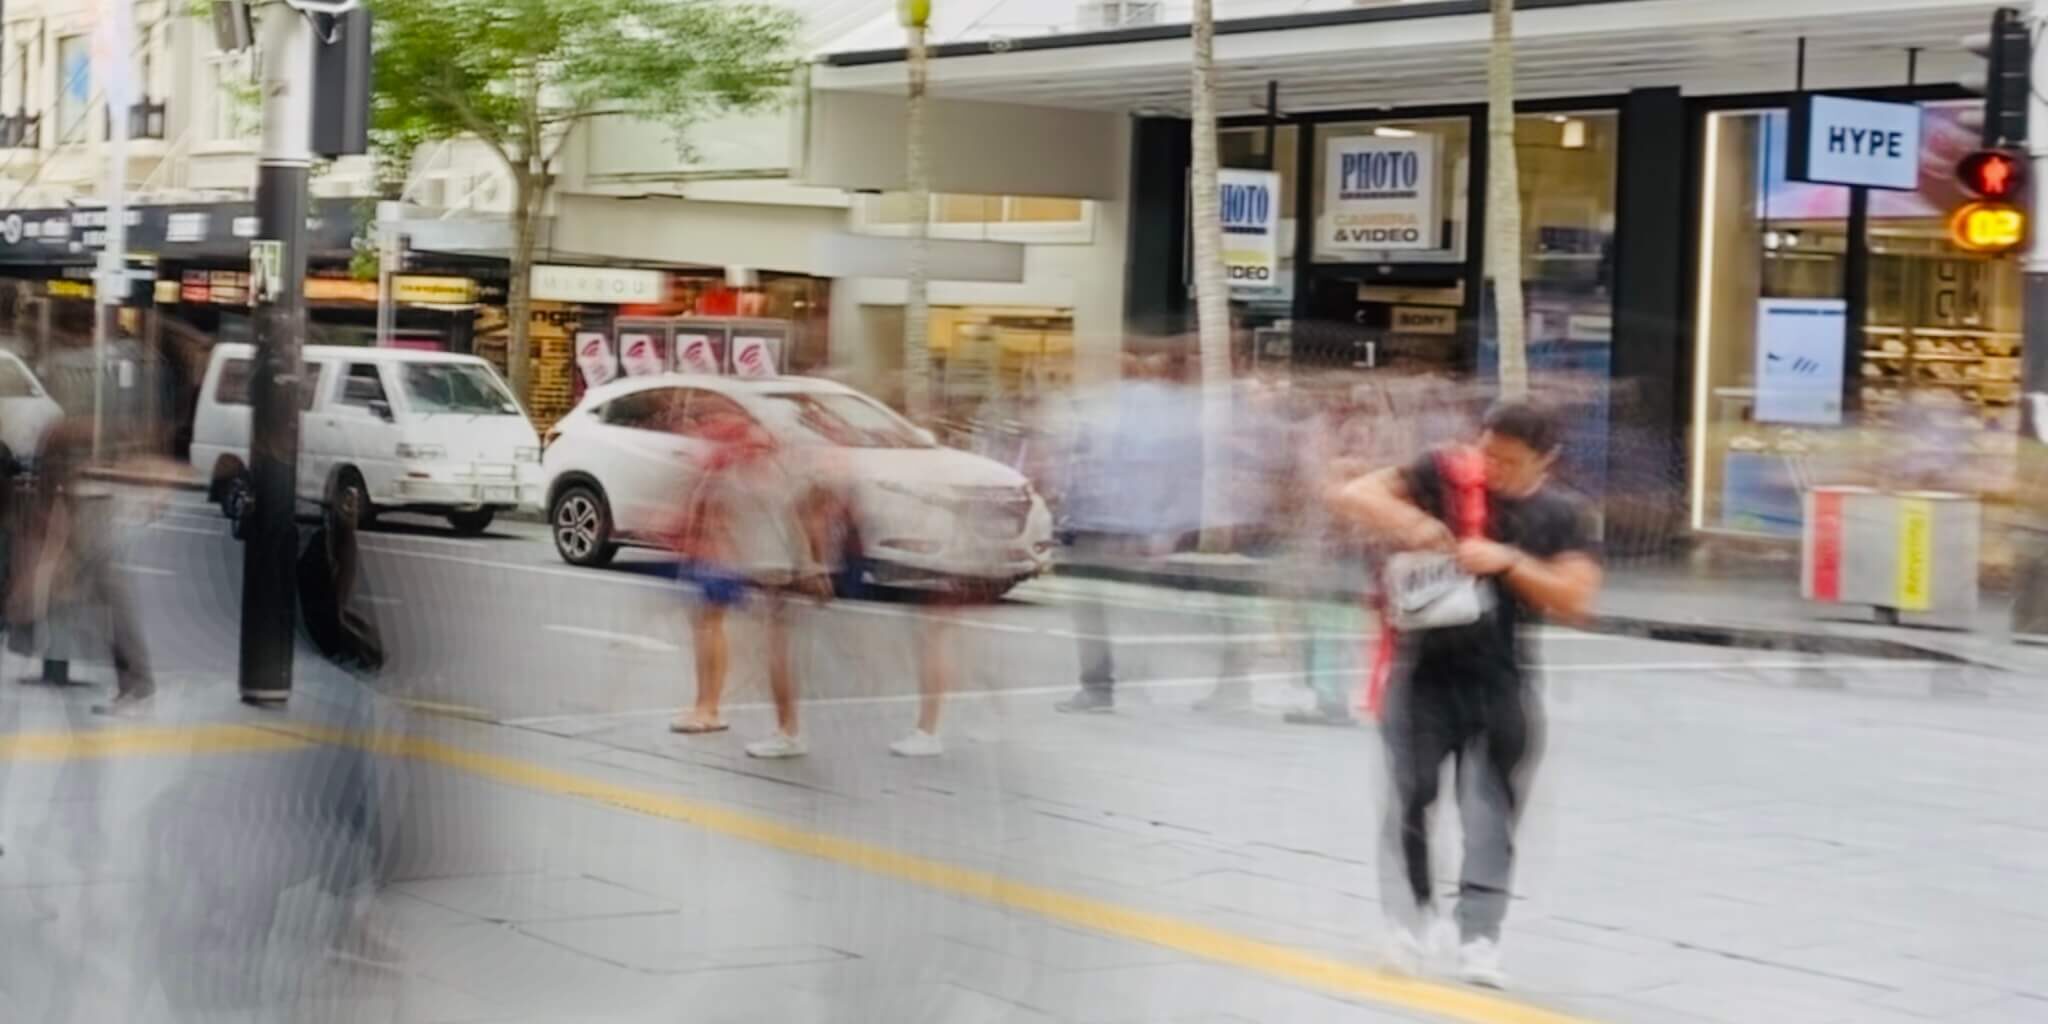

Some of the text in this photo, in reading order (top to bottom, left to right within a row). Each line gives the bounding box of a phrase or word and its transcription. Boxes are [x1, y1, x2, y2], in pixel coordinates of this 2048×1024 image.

[1828, 125, 1903, 158] HYPE
[1341, 150, 1419, 190] PHOTO
[1220, 184, 1269, 223] HOTO
[1333, 227, 1419, 242] & VIDEO
[1400, 312, 1446, 327] SONY
